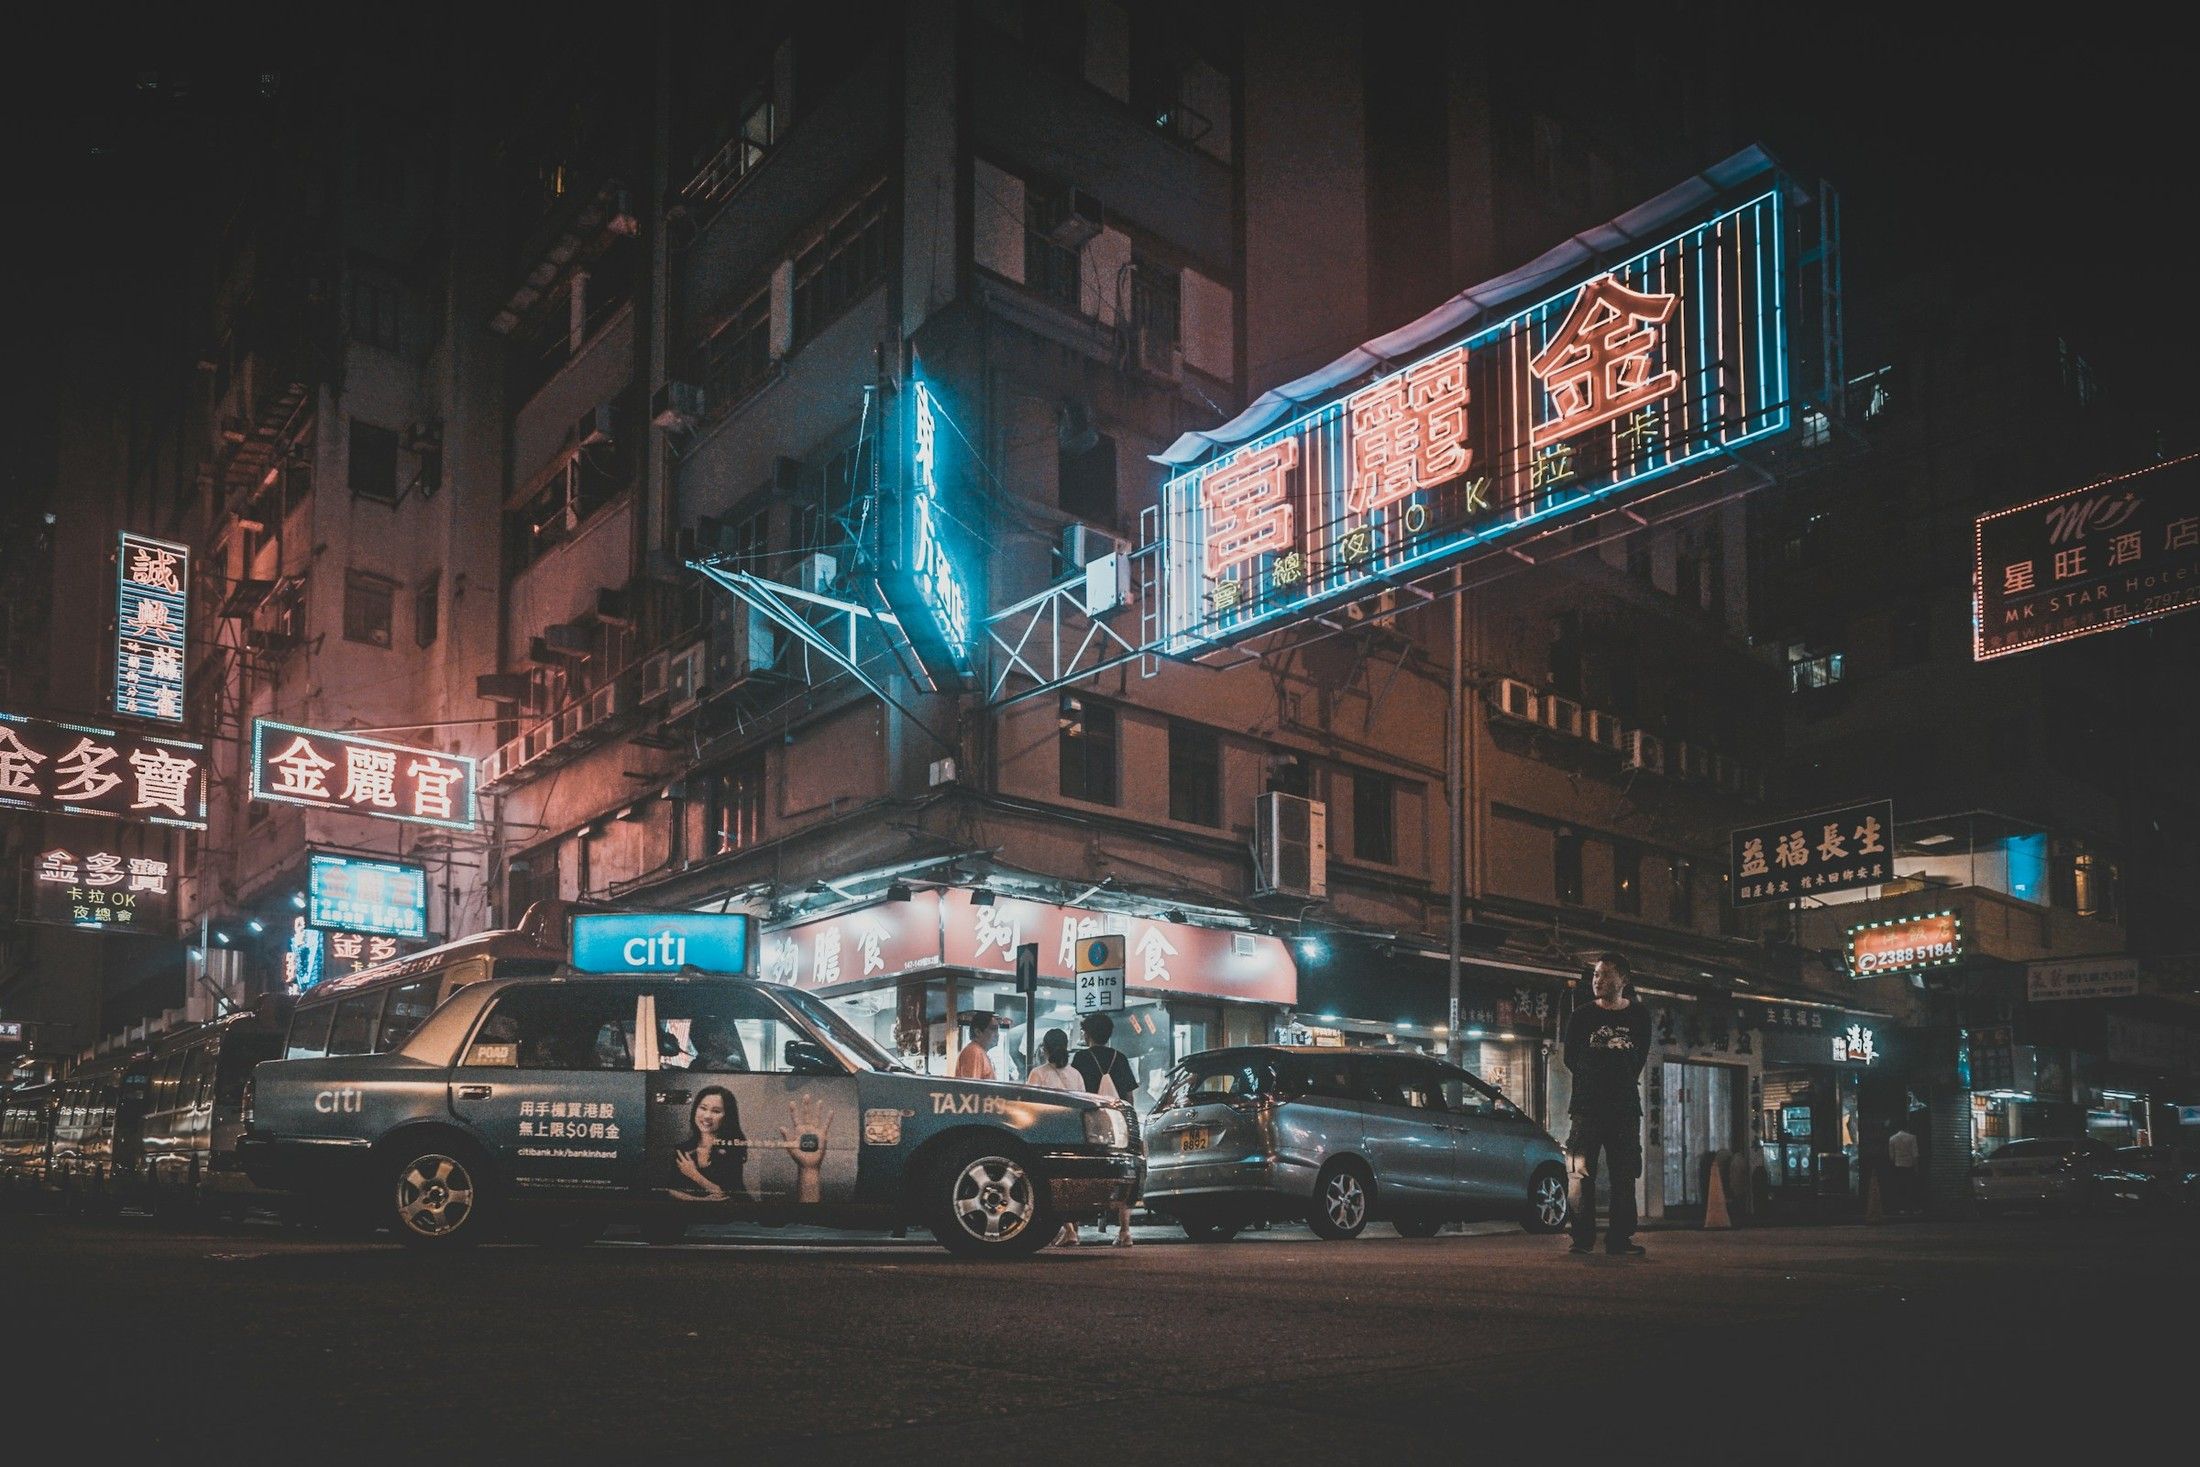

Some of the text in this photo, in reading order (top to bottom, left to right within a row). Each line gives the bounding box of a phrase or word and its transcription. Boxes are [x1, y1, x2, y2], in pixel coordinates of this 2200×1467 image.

[2005, 604, 2034, 624] MK
[2050, 585, 2109, 612] STAR
[0, 724, 197, 816] 金多寶
[267, 735, 464, 818] 金麗宮
[1740, 815, 1886, 878] 益福長生
[40, 848, 170, 895] 金多寶
[66, 886, 137, 908] 卡拉OK
[622, 928, 686, 967] citi
[1877, 941, 1954, 966] 2388 5184
[1081, 974, 1117, 989] 24 hrs
[1084, 991, 1112, 1008] 全日
[315, 1086, 361, 1113] citi
[519, 1101, 615, 1119] 用手機買港股
[929, 1092, 980, 1114] TAXI
[519, 1121, 620, 1139] 無上限$0佣金
